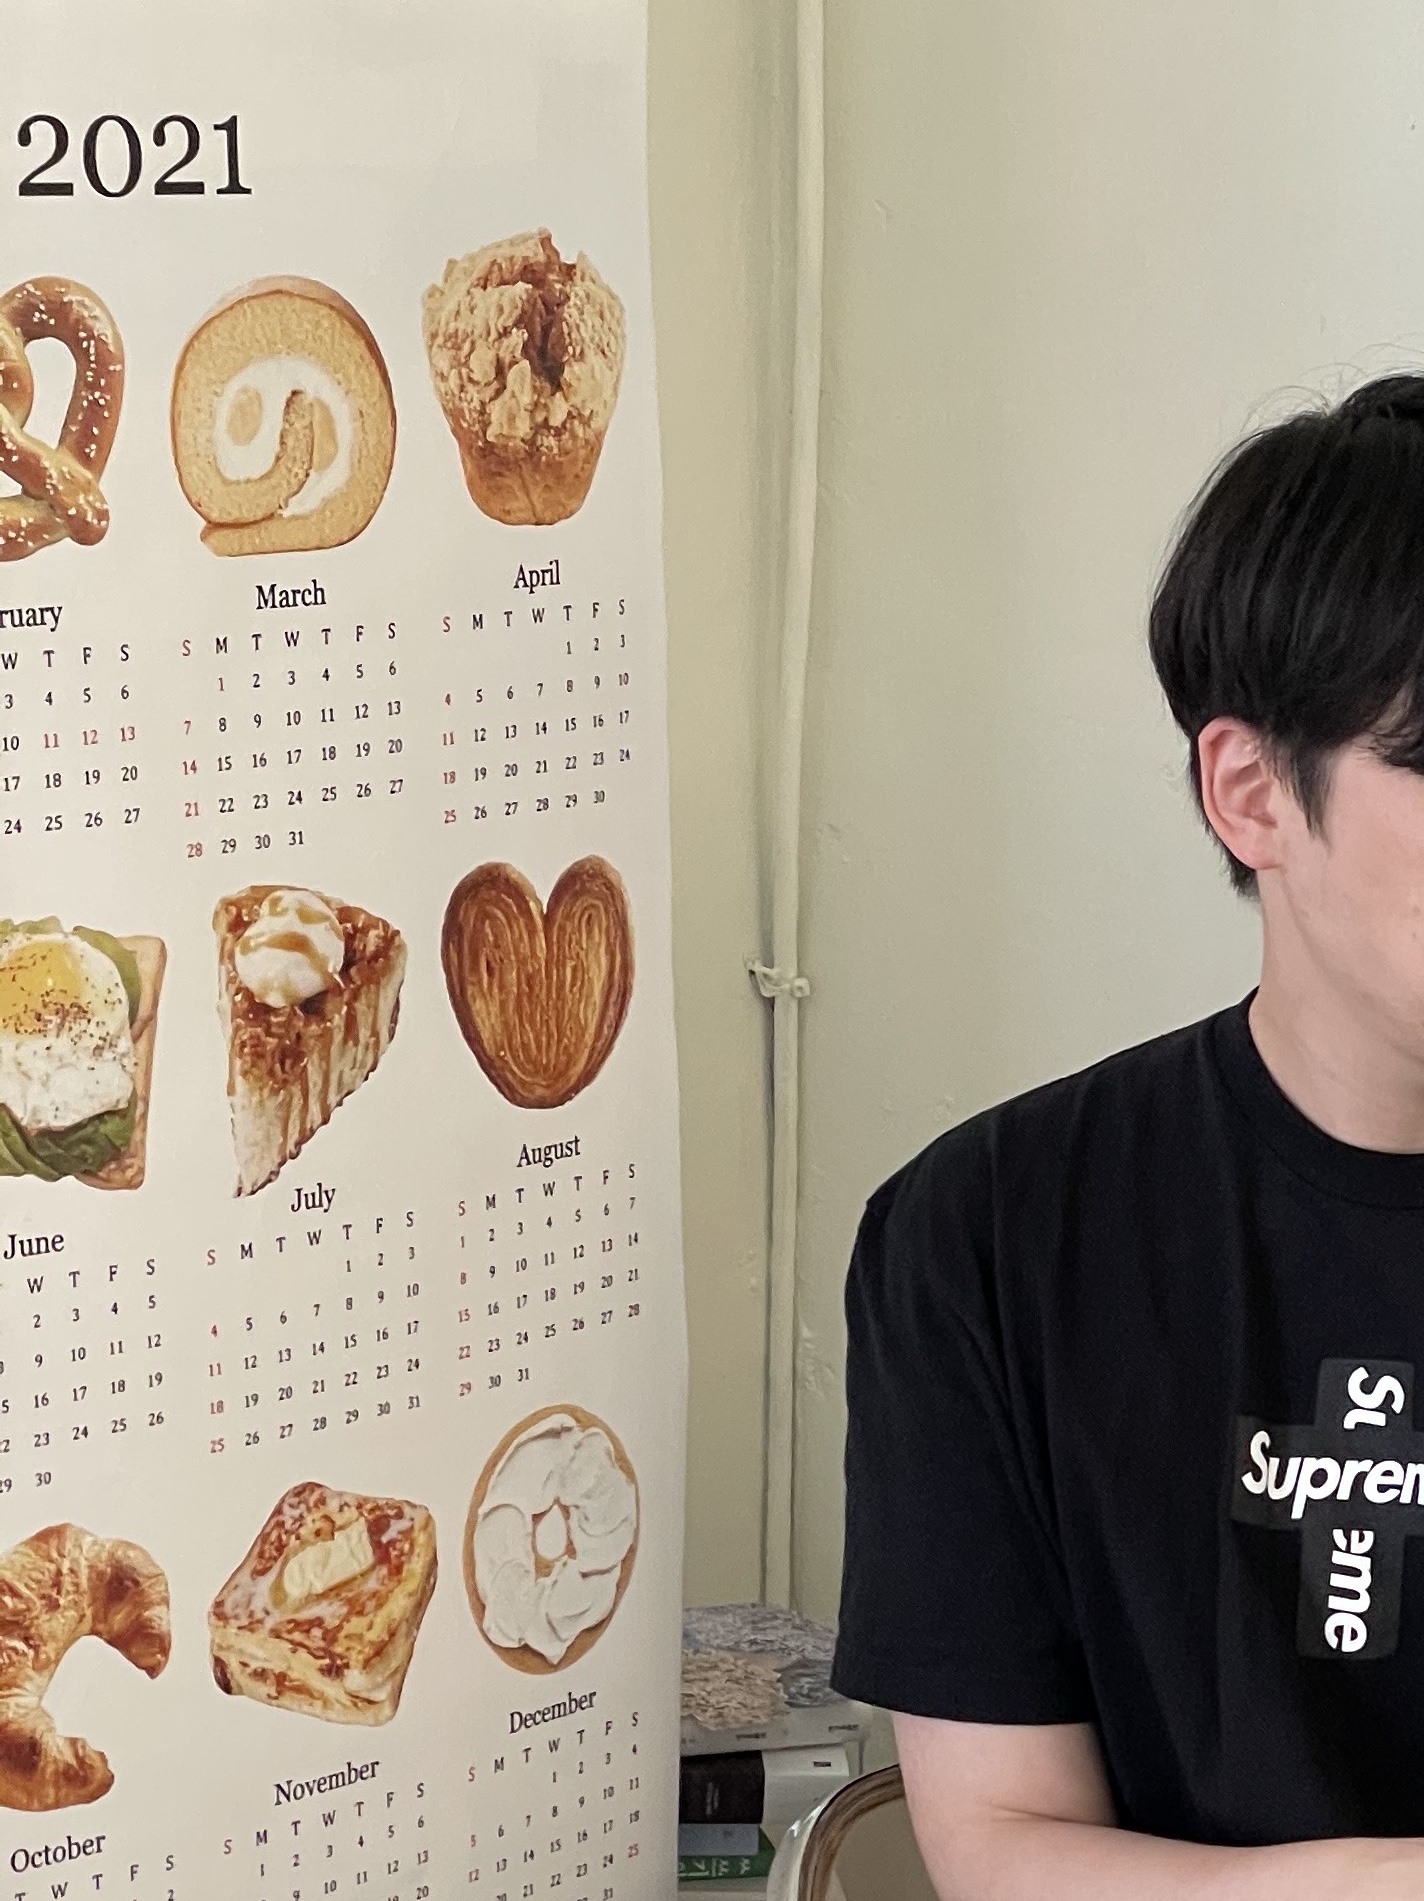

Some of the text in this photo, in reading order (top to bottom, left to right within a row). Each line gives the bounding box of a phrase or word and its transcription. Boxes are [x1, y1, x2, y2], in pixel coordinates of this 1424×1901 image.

[18, 114, 252, 198] 2021
[513, 559, 560, 594] April
[255, 579, 327, 611] March
[442, 598, 626, 633] S M T W T F S
[0, 643, 131, 671] W T F S
[182, 622, 397, 657] S M T W T F S
[566, 634, 626, 656] 1 2 3
[218, 660, 397, 692] 1 2 3 4 5 6
[4, 684, 130, 710] 3 4 5 6
[183, 700, 402, 736] 7 8 9 10 11 12 13
[2, 725, 136, 753] 10 11 12 13
[182, 738, 403, 776] 14 15 16 17 18 19 20
[2, 765, 139, 792] 17 18 19 20
[184, 778, 404, 818] 21 22 23 24 25 26 27
[3, 807, 141, 835] 24 25 26 27
[186, 830, 305, 859] 28 29 30 31
[516, 1135, 580, 1168] August
[291, 1182, 336, 1213] July
[457, 1163, 636, 1217] S M T W T F S
[3, 1233, 64, 1260] June
[206, 1210, 414, 1266] S M T W T F S
[26, 1258, 156, 1295] W T F S
[346, 1246, 416, 1273] 1 2 3
[32, 1294, 157, 1329] 2 3 4 5
[34, 1333, 162, 1369] 9 10 11 12
[33, 1371, 164, 1409] 16 17 18 19
[33, 1410, 165, 1448] 23 24 25 26
[34, 1471, 52, 1488] 30
[509, 1690, 597, 1734] December
[468, 1711, 639, 1783] S M T W T F S
[274, 1758, 380, 1806] November
[223, 1782, 425, 1856] S M T W T F S
[11, 1834, 106, 1873] October
[50, 1881, 69, 1900] W
[91, 1873, 104, 1891] T
[129, 1863, 140, 1882] F
[165, 1854, 175, 1872] S
